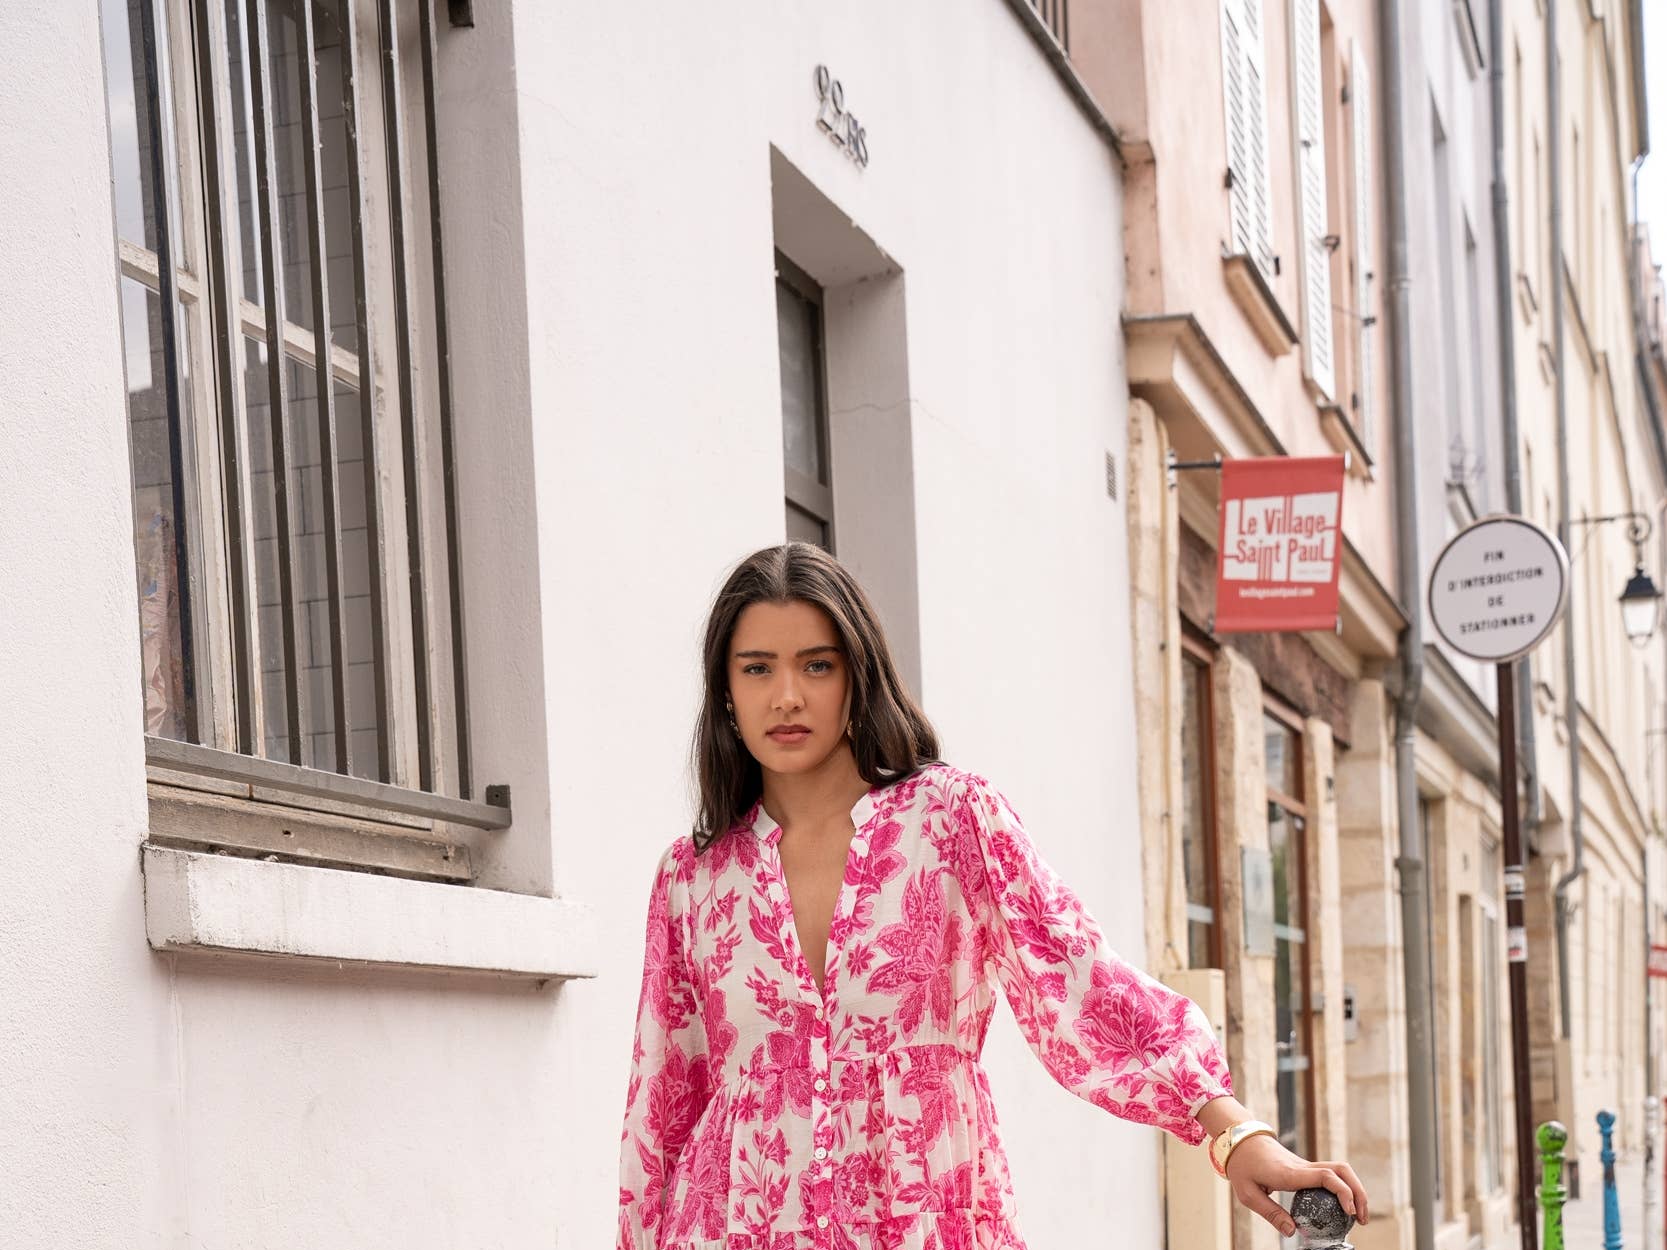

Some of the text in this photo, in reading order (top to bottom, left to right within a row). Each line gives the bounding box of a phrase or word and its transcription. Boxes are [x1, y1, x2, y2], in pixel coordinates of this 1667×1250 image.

[1238, 500, 1332, 538] Le Village
[1236, 538, 1330, 572] Saint Paul
[1484, 551, 1504, 562] FIN
[1488, 596, 1503, 607] DE
[1460, 613, 1535, 634] STATIONNER
